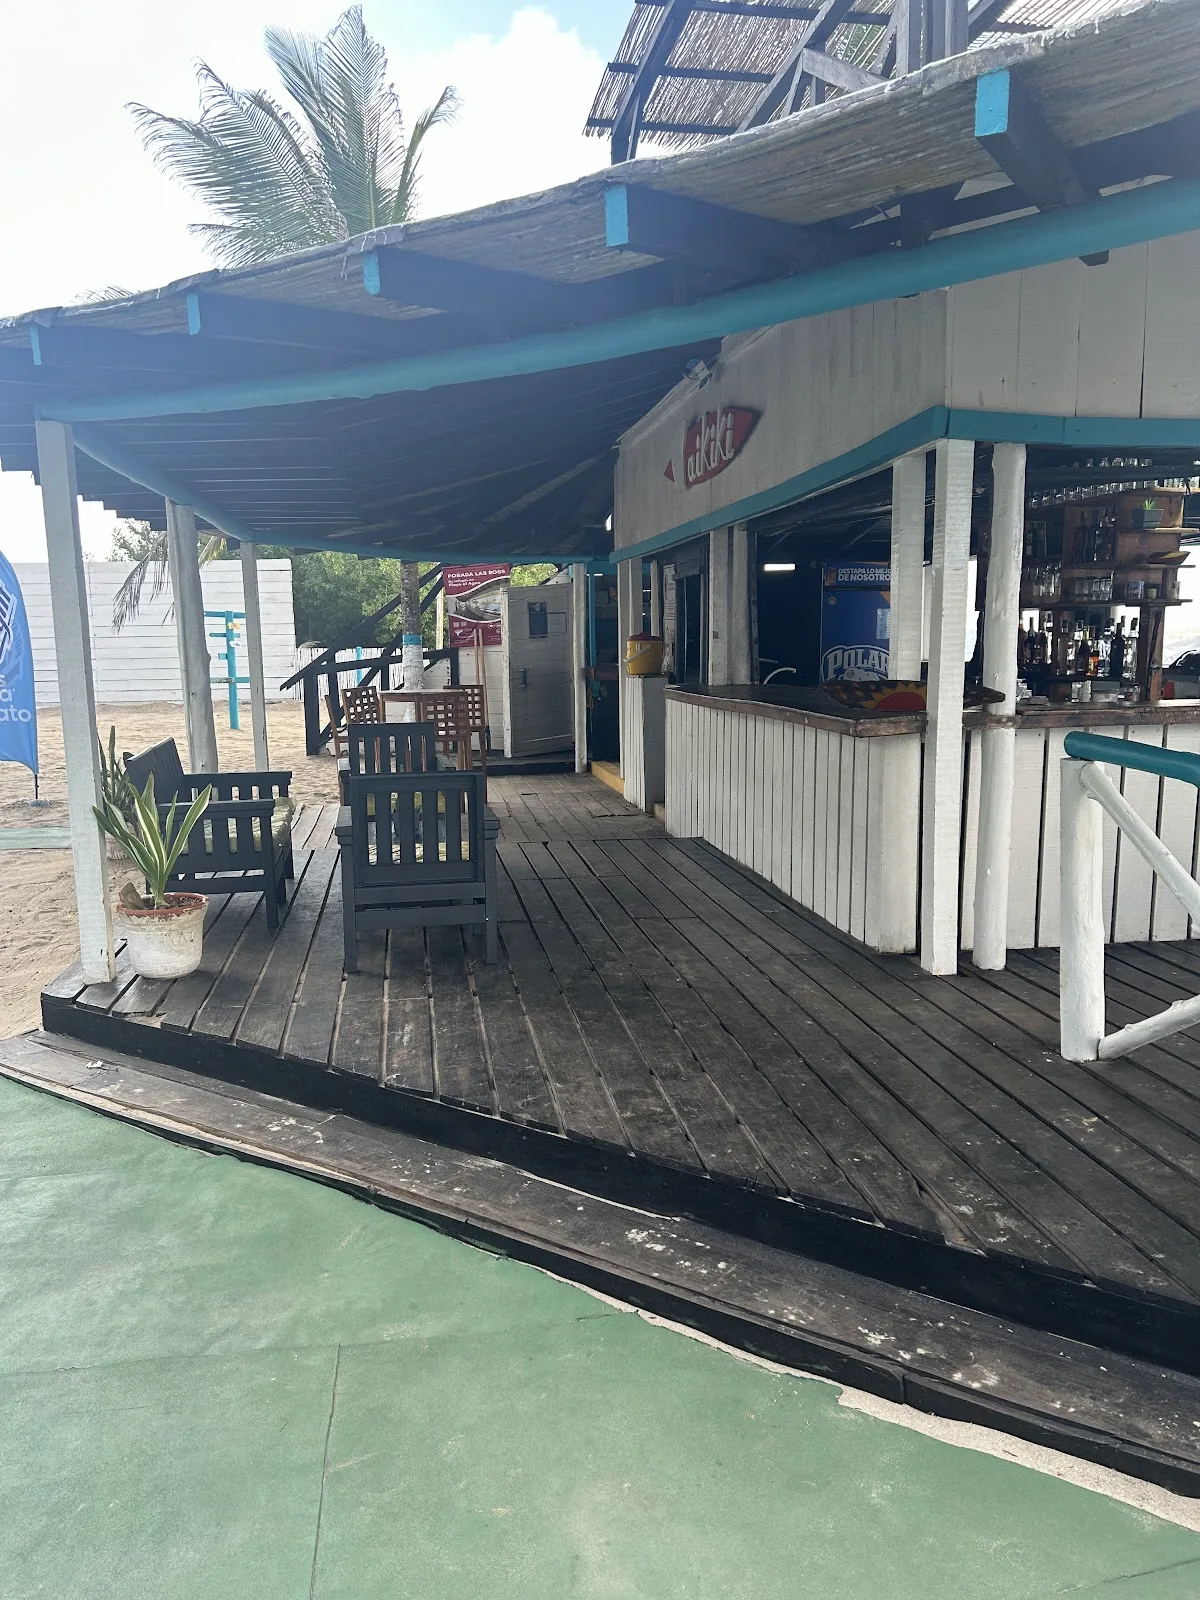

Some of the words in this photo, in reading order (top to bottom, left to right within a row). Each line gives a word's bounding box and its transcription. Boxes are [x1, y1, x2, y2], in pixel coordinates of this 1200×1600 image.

[837, 573, 849, 581] DE
[850, 573, 891, 581] NOSOTRO
[0, 704, 32, 723] ato
